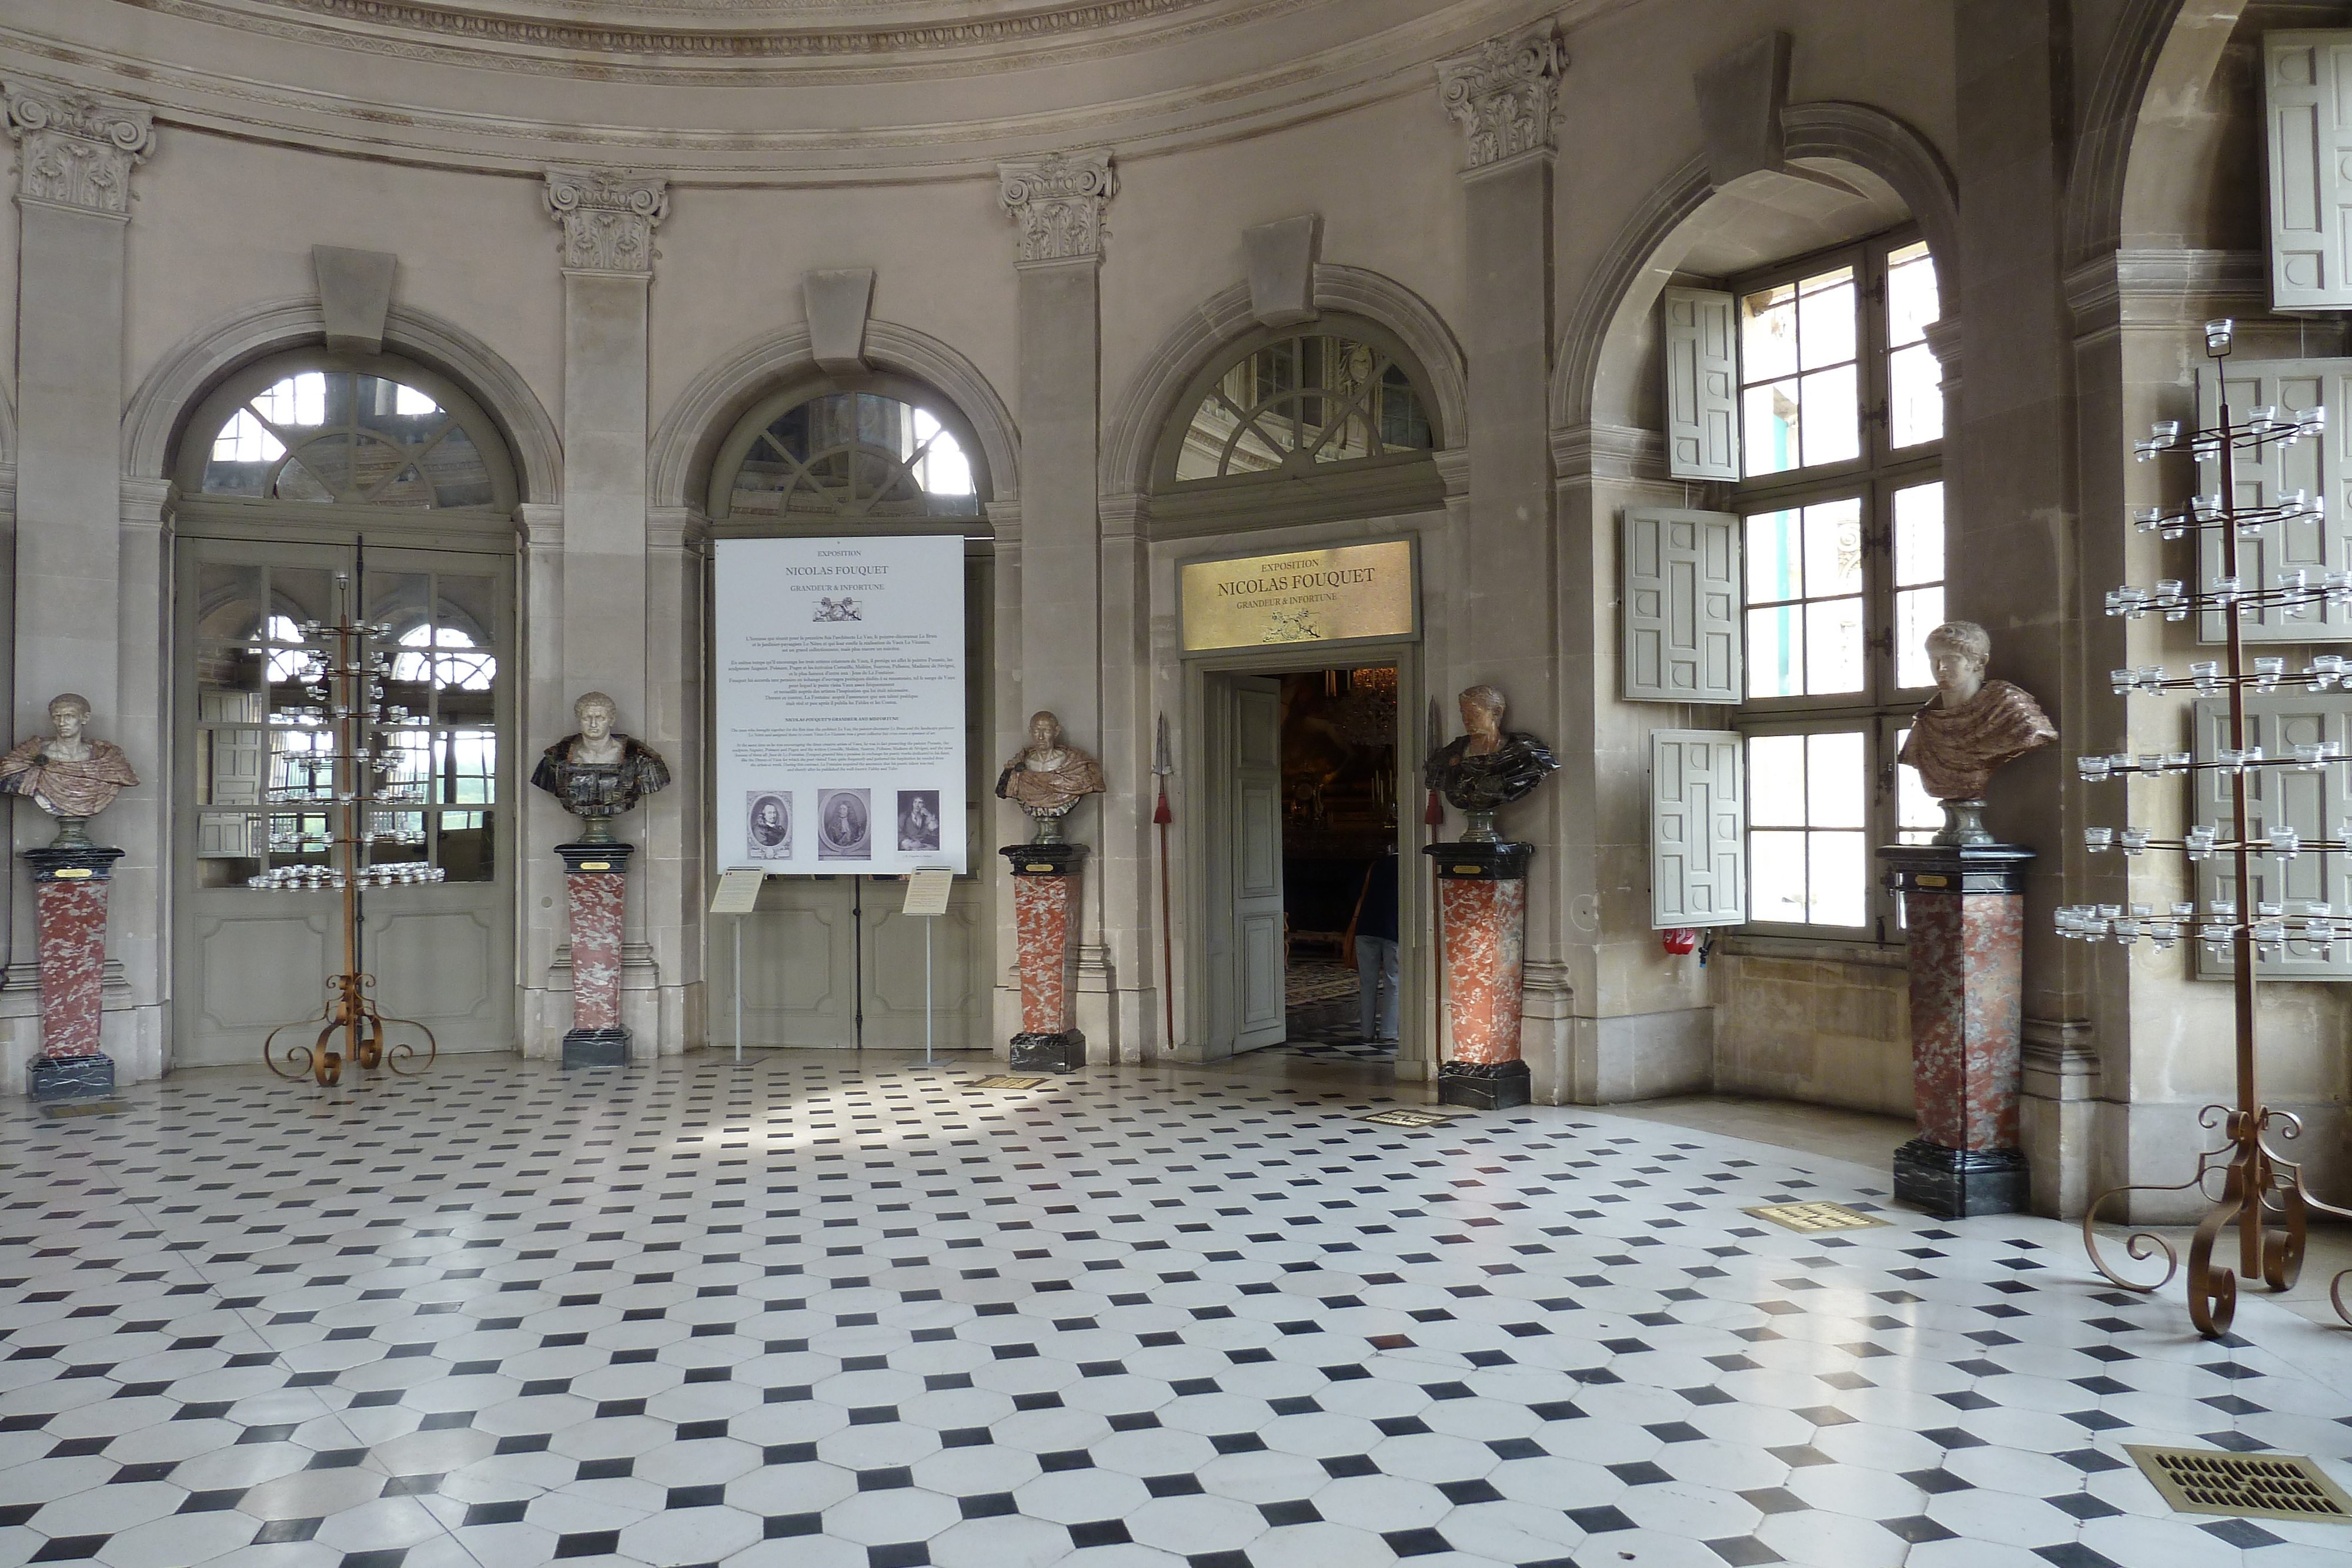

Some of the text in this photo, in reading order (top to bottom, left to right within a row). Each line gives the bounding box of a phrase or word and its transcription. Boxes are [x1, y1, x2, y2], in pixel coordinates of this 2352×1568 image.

[786, 566, 889, 576] NICOLAS FOUQUET
[1261, 559, 1319, 572] EXPOSITION
[1218, 567, 1375, 597] NICOLAS FOUQUET
[1237, 597, 1281, 609] GRANDEUR
[1289, 593, 1337, 604] INFORTUNE
